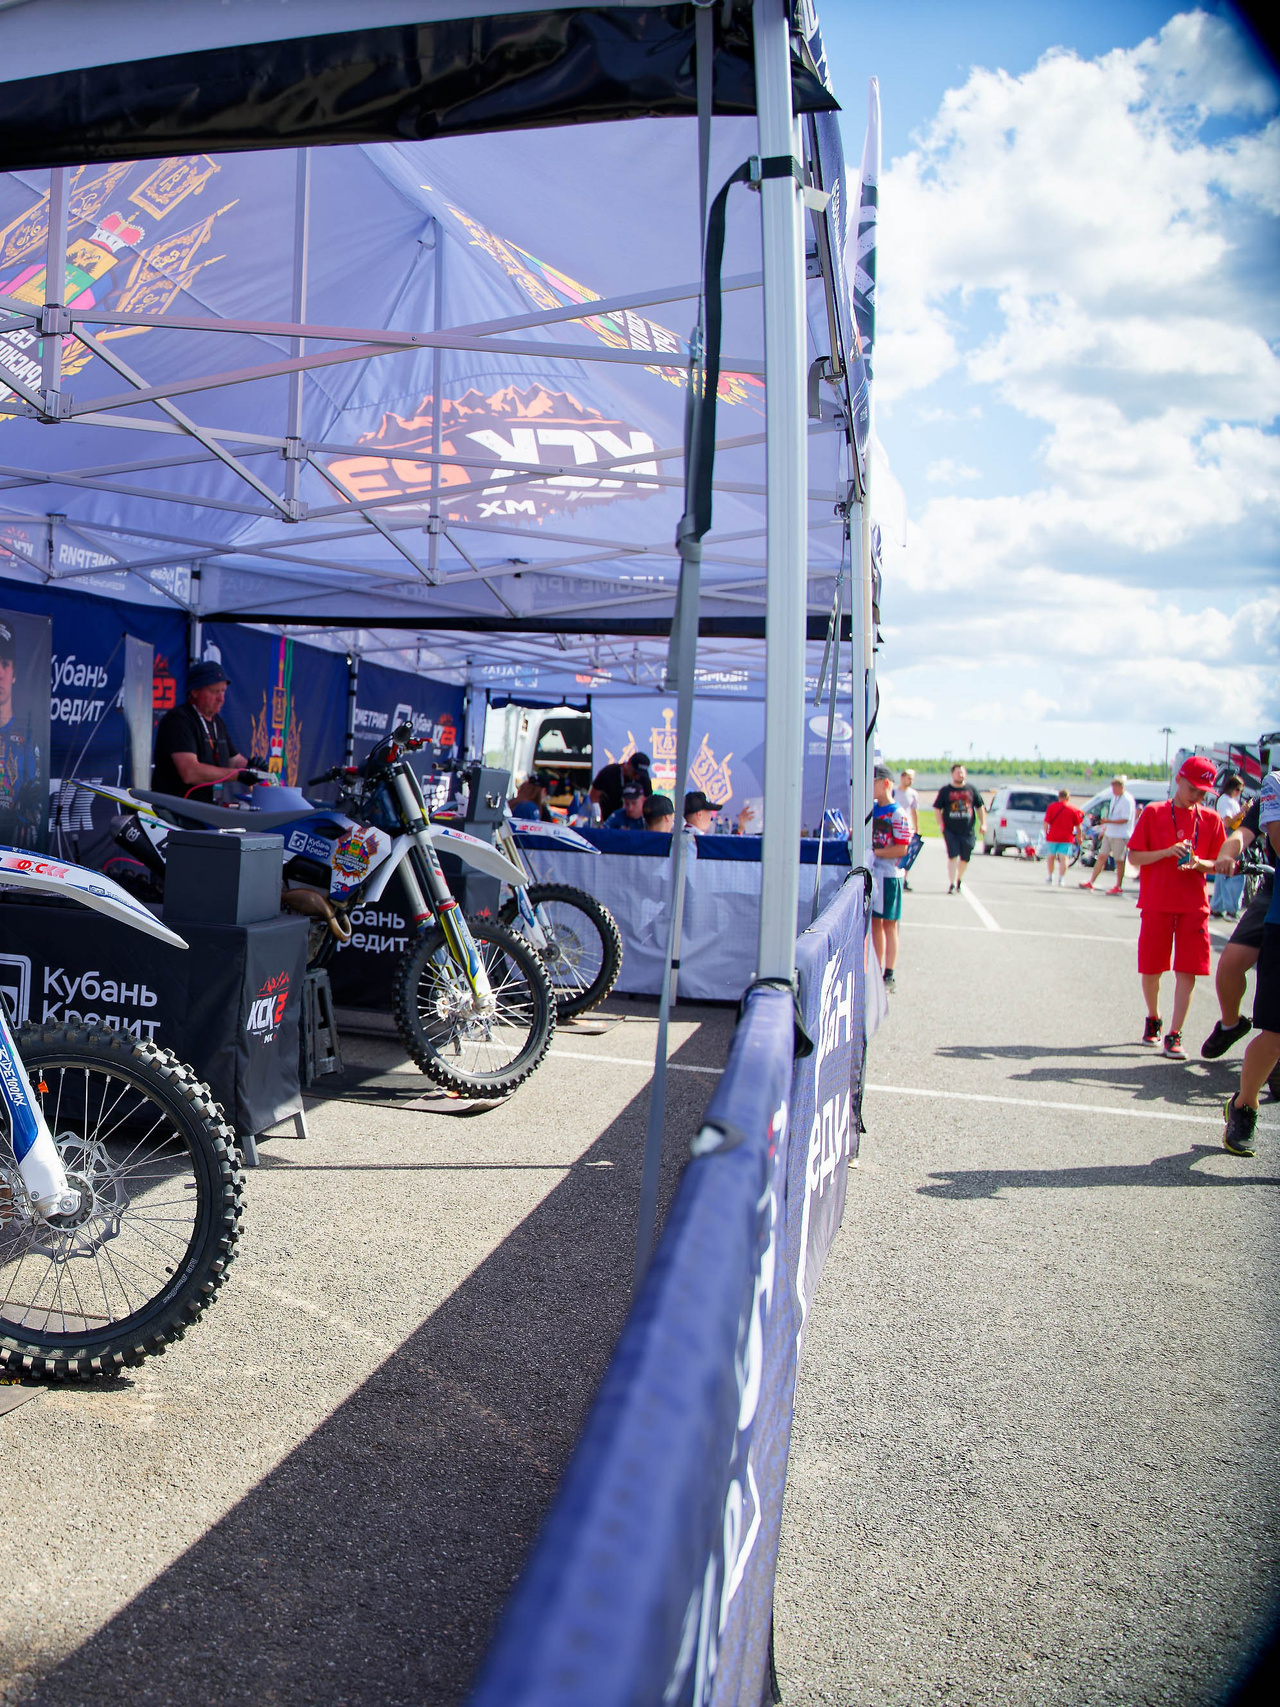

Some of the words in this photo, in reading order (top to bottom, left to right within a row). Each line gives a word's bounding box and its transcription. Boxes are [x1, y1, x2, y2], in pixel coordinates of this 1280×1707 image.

[50, 697, 105, 725] редит
[43, 965, 158, 1008] Кубань
[247, 994, 277, 1031] КСК
[274, 991, 288, 1025] 2
